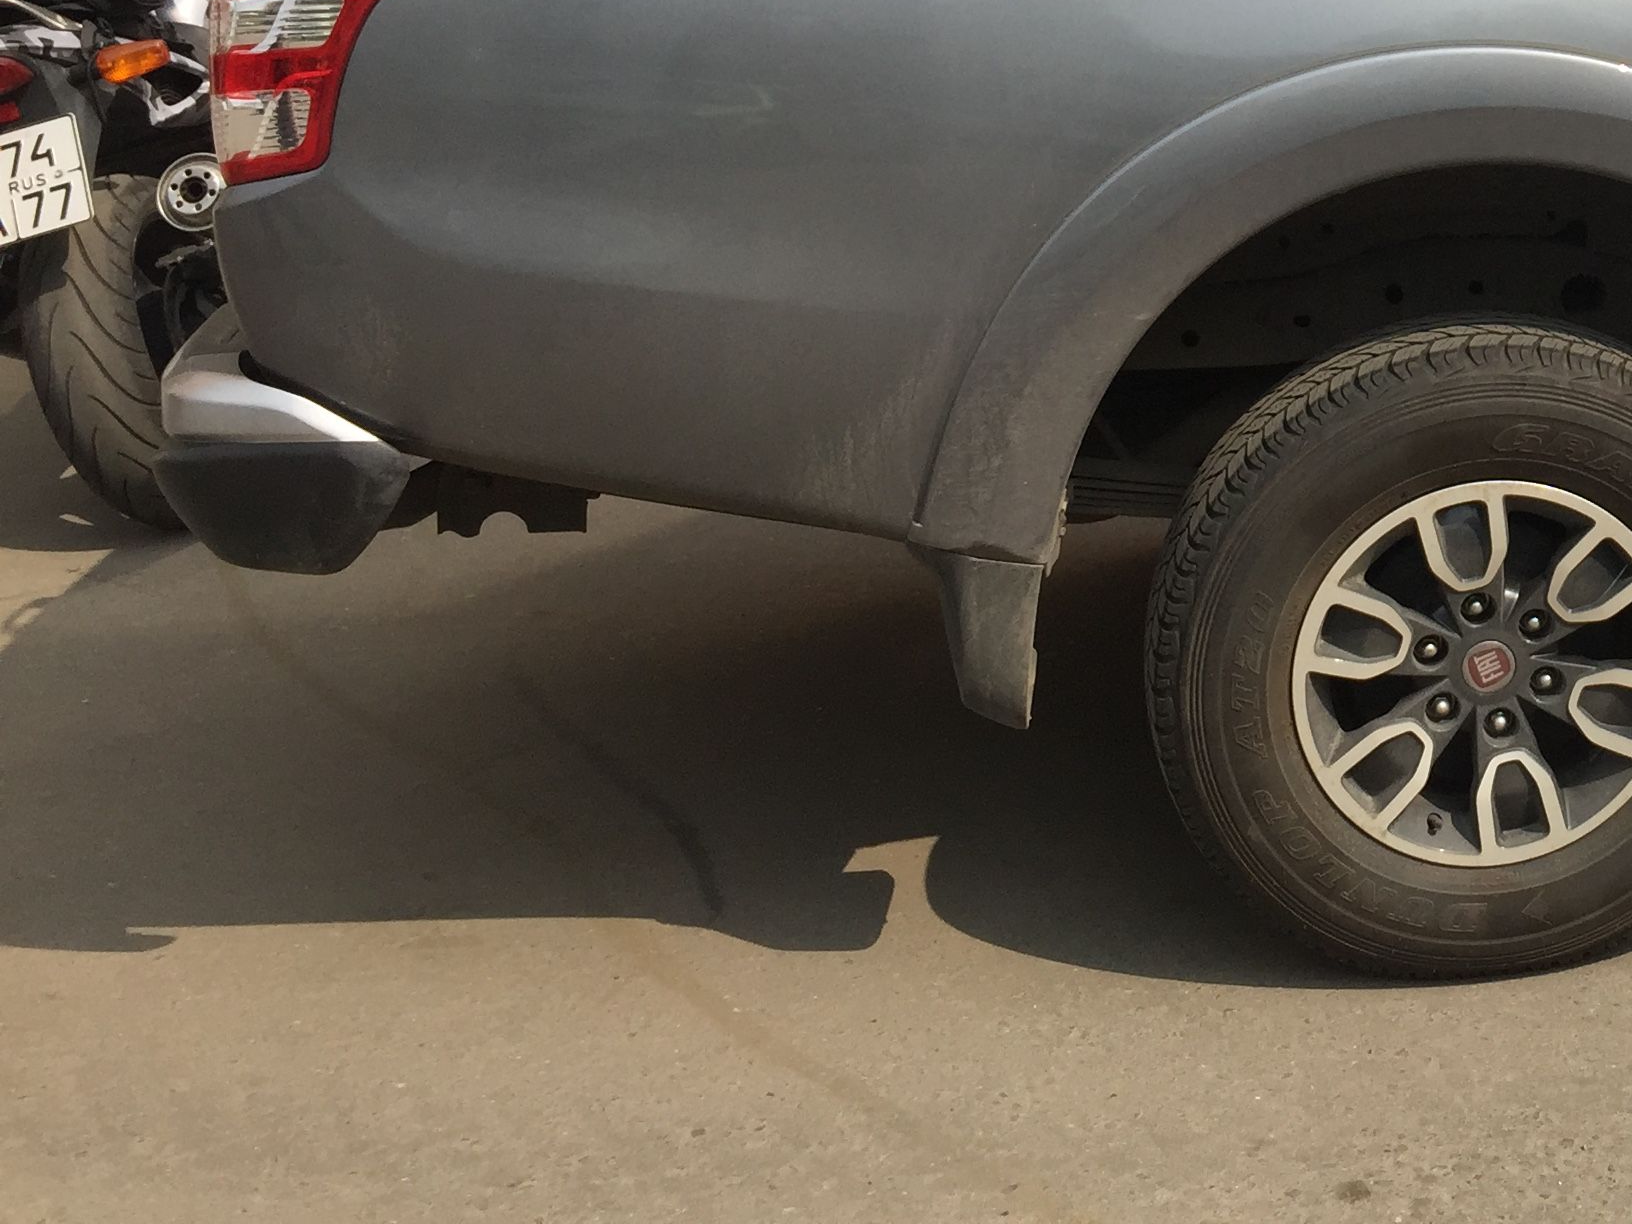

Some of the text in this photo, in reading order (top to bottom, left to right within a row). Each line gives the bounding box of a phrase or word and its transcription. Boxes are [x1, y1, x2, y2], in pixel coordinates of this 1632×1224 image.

[0, 131, 57, 178] 74
[8, 172, 47, 195] RUS
[21, 179, 73, 230] 77
[1473, 650, 1505, 683] FIAT
[1252, 790, 1488, 936] DUNLOP
